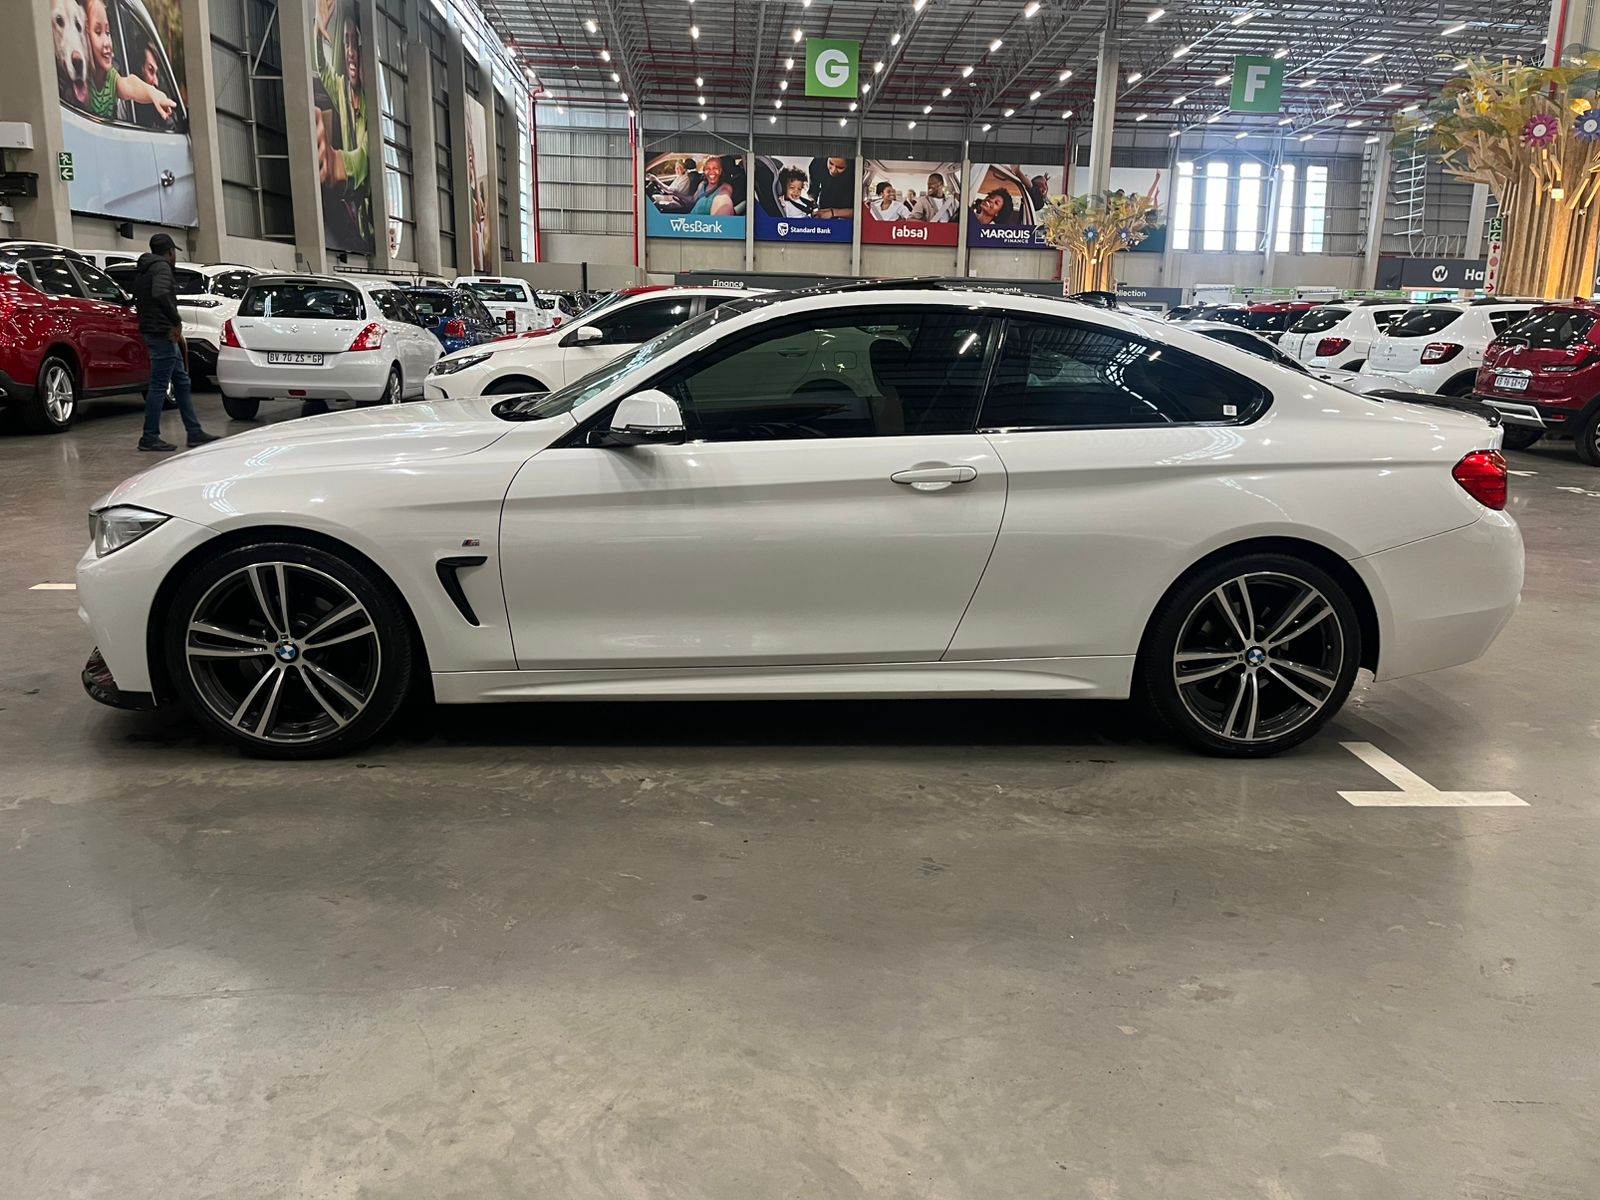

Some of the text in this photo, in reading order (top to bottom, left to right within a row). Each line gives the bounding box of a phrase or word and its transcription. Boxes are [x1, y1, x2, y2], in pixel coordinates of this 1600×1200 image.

[815, 49, 849, 88] G
[1244, 65, 1271, 103] F
[670, 218, 723, 233] WesBank
[790, 226, 832, 235] Standard Bank
[891, 225, 928, 240] (absa)
[980, 228, 1031, 239] MARQUIS
[712, 279, 744, 288] Finance
[1115, 289, 1147, 297] ollection
[270, 352, 279, 361] BV
[295, 353, 305, 362] ZS
[312, 354, 322, 363] GP
